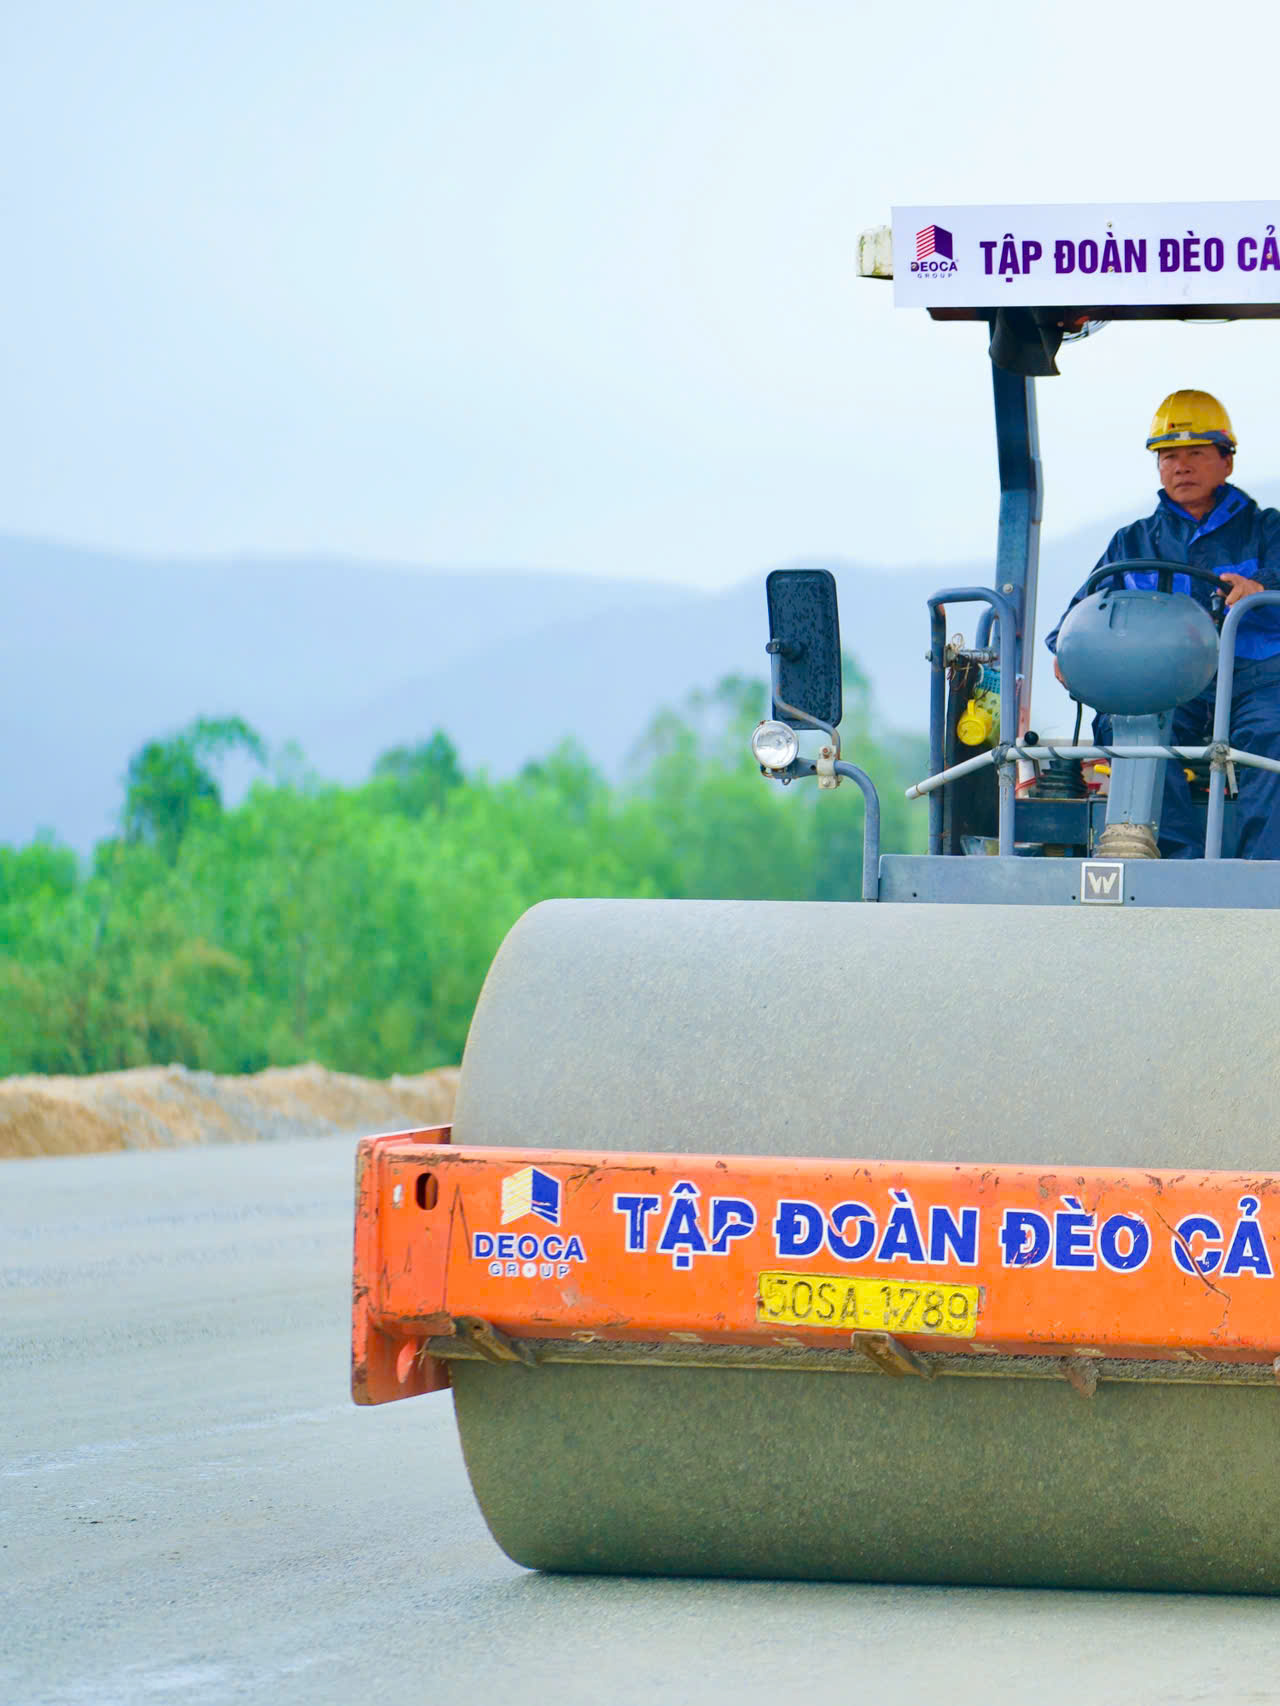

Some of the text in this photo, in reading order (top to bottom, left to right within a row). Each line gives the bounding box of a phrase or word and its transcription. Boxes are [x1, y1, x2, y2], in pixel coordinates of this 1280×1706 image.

[911, 261, 958, 272] DEOCA
[979, 233, 1043, 283] TẬP
[1054, 232, 1147, 274] ĐOÀN
[1159, 230, 1225, 273] ĐÈO
[613, 1180, 1275, 1278] TẬP ĐOÀN ĐÈO CẢ
[473, 1233, 585, 1263] DEOCA
[488, 1262, 570, 1278] GROUP
